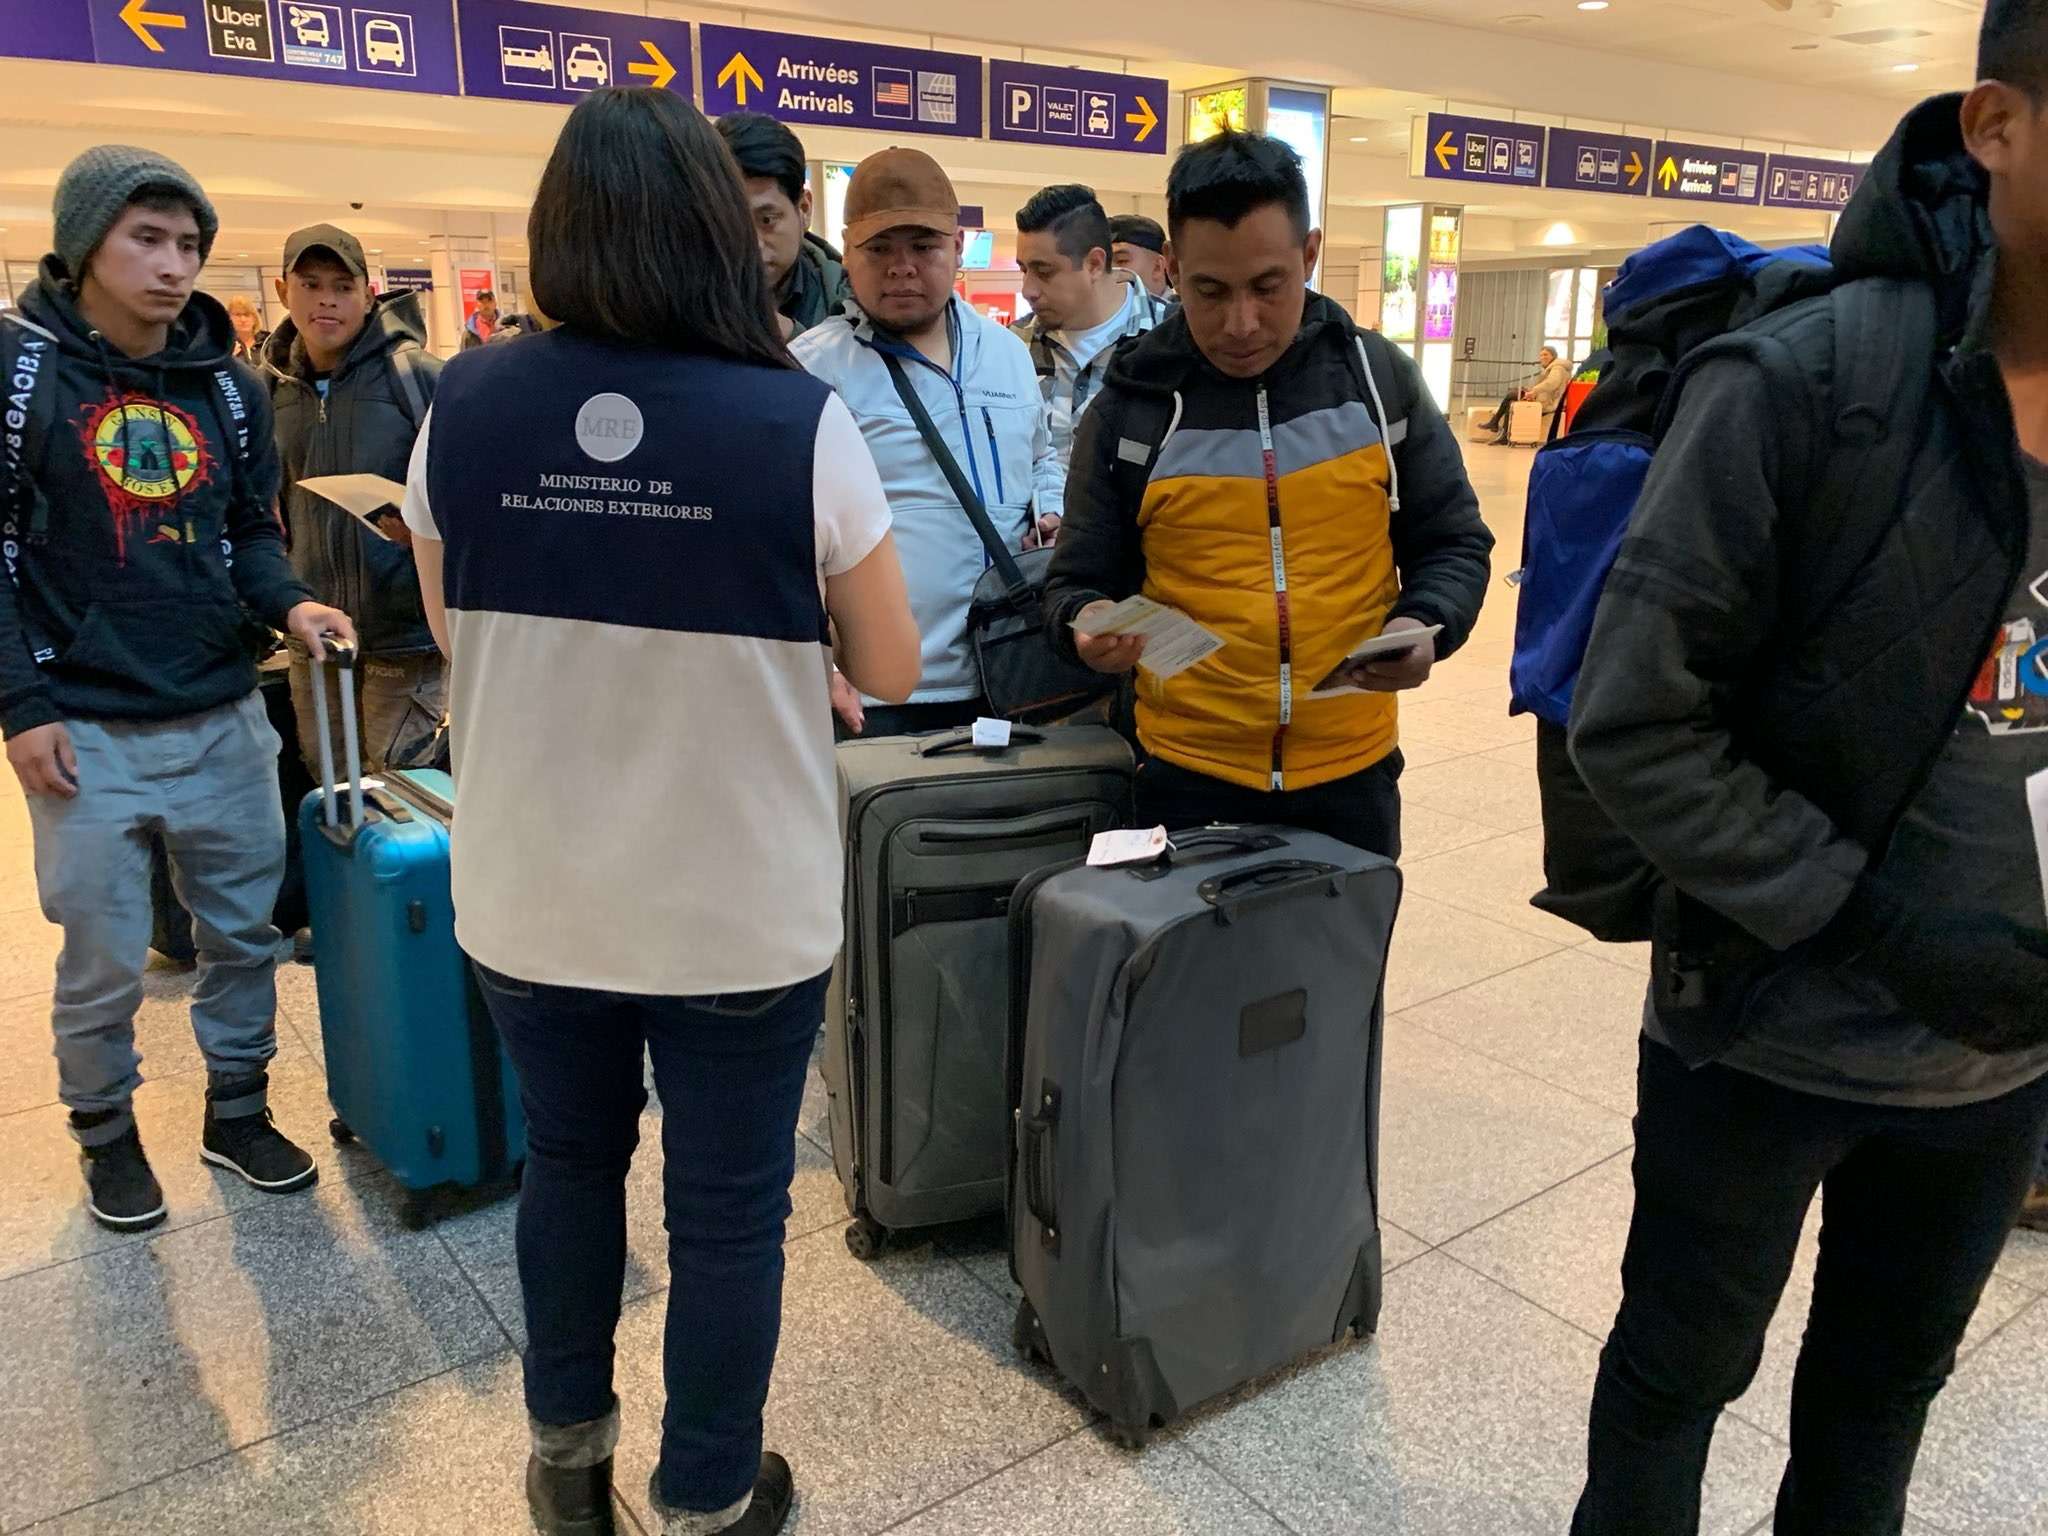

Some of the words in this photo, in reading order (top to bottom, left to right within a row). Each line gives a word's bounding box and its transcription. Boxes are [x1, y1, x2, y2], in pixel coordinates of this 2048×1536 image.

[212, 4, 262, 28] Uber
[223, 29, 257, 51] Eva
[324, 53, 343, 65] 747
[777, 57, 859, 85] Arrivées
[778, 88, 854, 115] Arrivals
[1012, 89, 1032, 124] P
[1047, 101, 1075, 112] VALET
[1049, 111, 1073, 121] PARC
[1467, 140, 1486, 153] Uber
[1469, 155, 1482, 167] Eva
[1682, 158, 1717, 176] Arrivées
[1680, 177, 1713, 195] Arrivals
[581, 416, 638, 440] MRE
[539, 474, 641, 493] MINISTERIO
[648, 480, 673, 495] DE
[501, 493, 604, 514] RELACIONES
[607, 501, 713, 521] EXTERIORES
